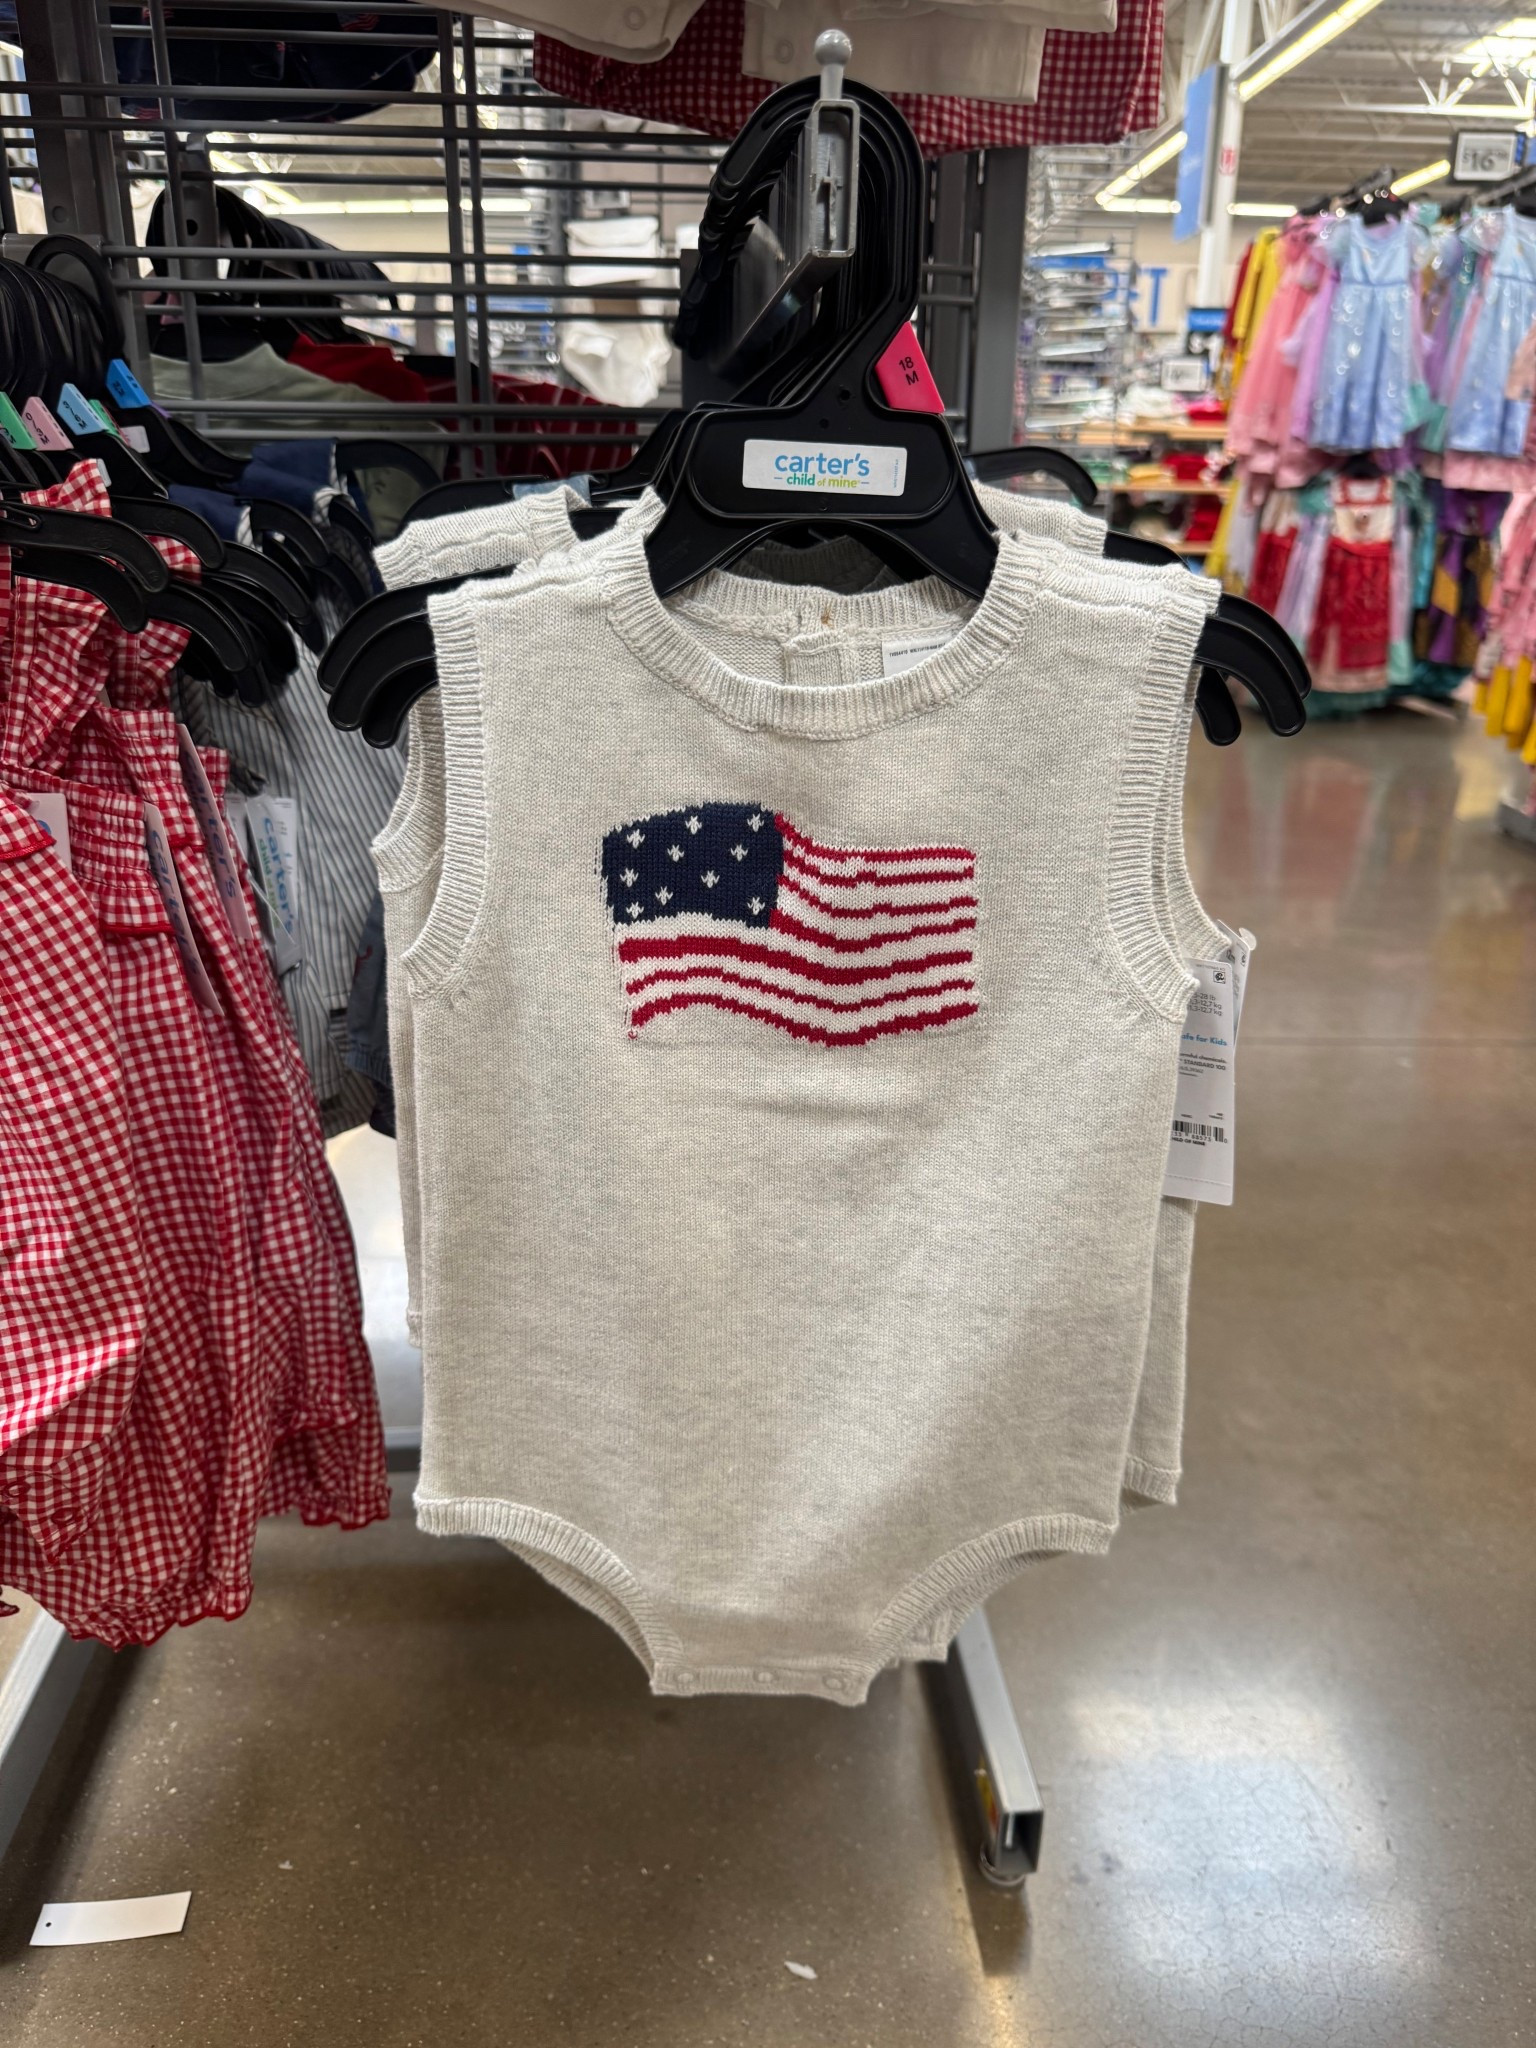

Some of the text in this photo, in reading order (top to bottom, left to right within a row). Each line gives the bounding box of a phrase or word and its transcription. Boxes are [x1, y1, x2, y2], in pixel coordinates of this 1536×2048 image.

[898, 356, 914, 371] 18
[906, 370, 919, 385] M
[774, 452, 870, 477] carter's
[786, 473, 858, 488] child of mine
[264, 817, 294, 934] carter's
[1181, 1032, 1227, 1046] afe for Kids
[1183, 1059, 1215, 1069] STANDARD
